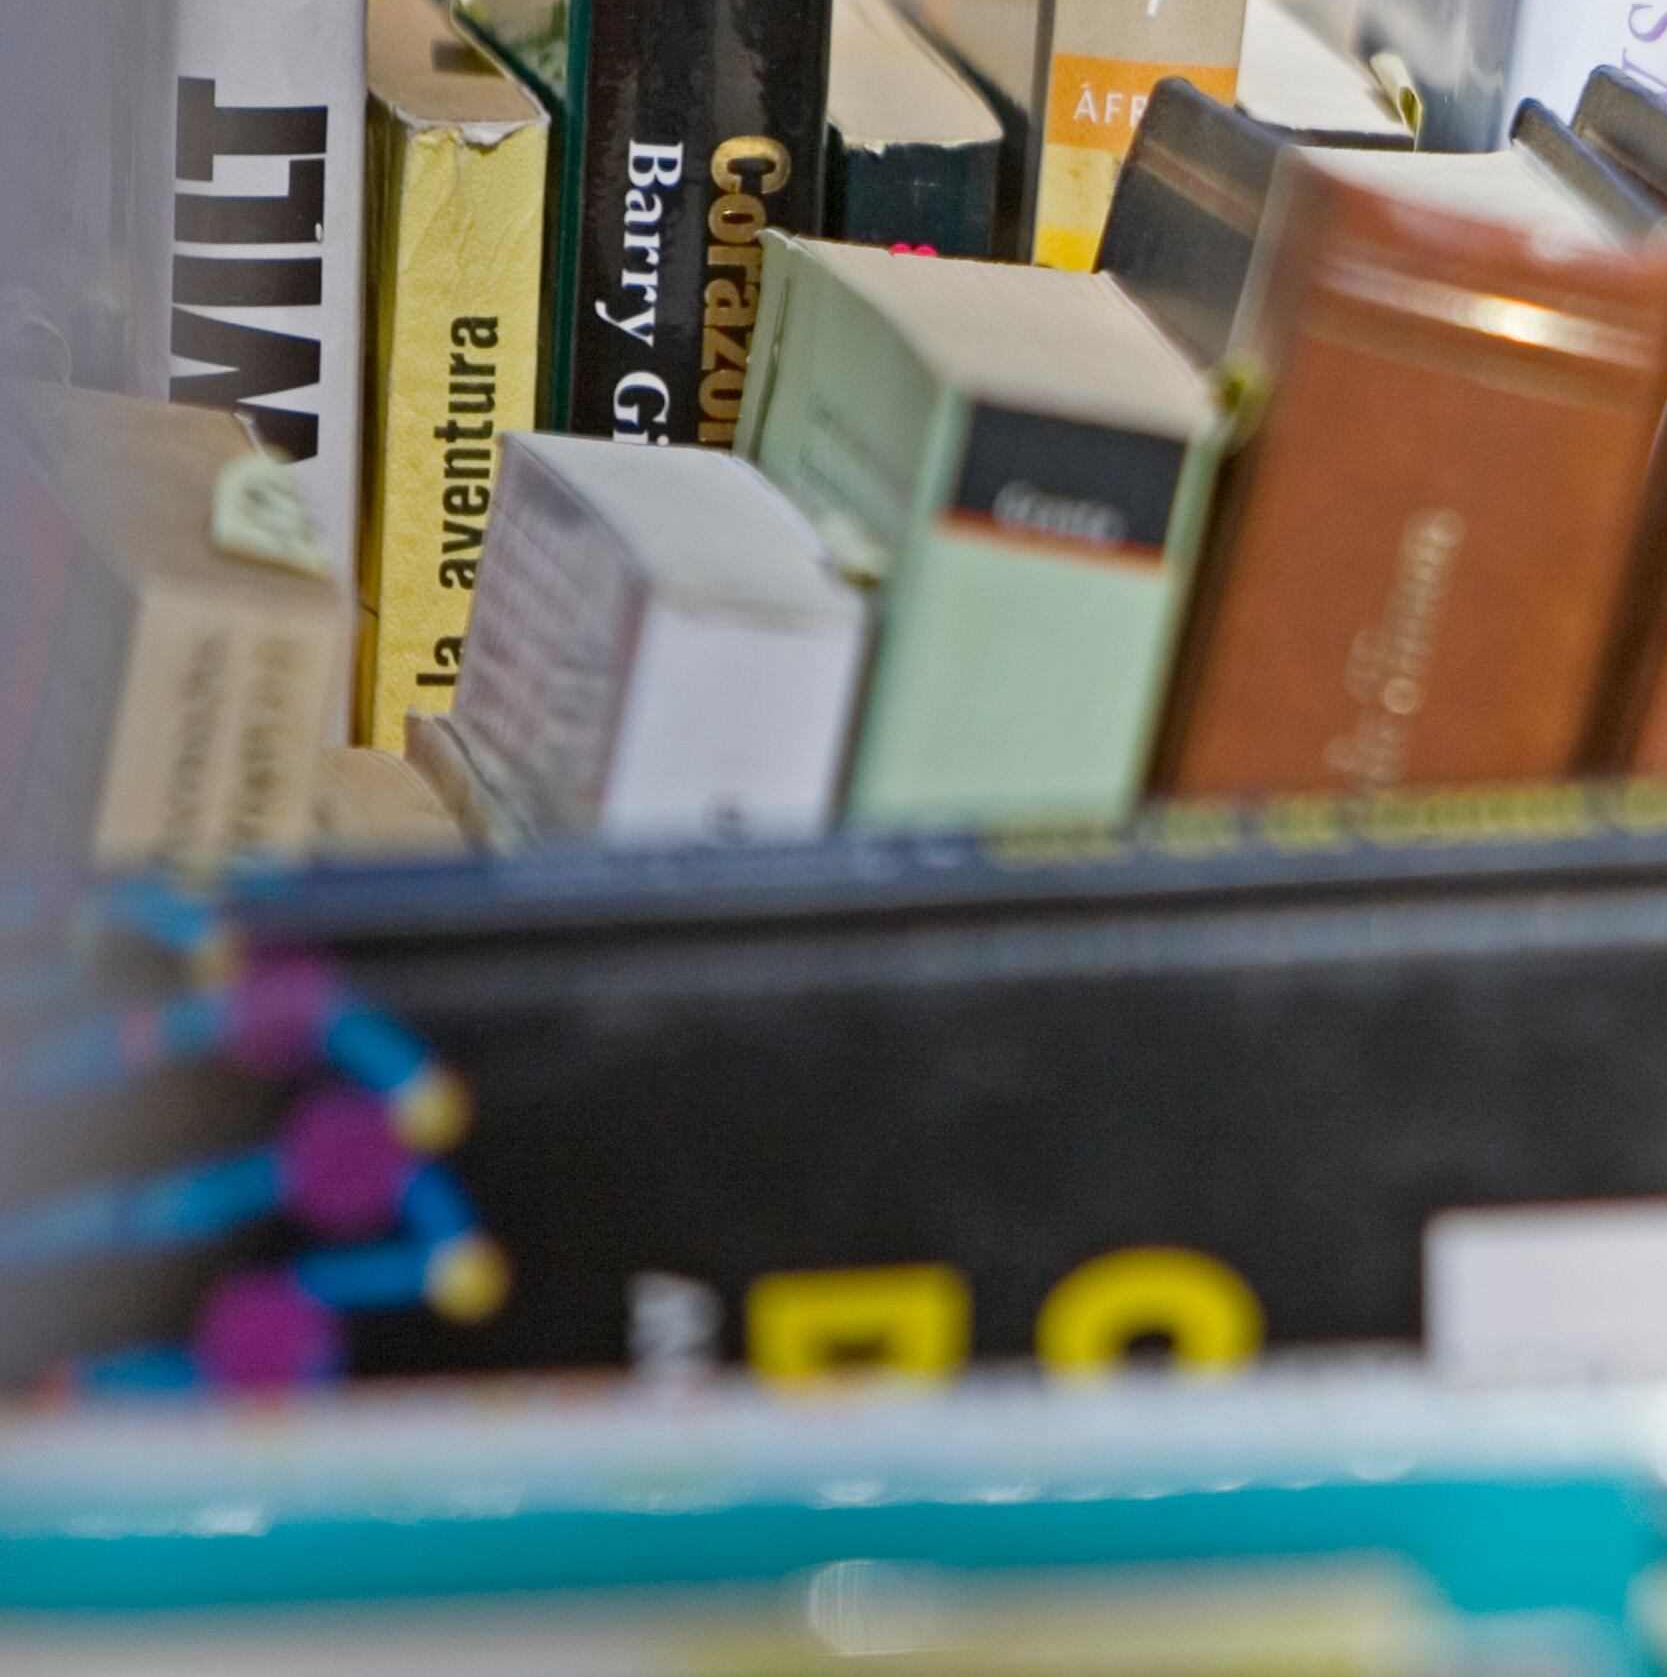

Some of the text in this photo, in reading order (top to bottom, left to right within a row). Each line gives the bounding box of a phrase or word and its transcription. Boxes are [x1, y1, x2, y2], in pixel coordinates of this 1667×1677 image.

[169, 76, 328, 464] WILT
[595, 138, 684, 348] Barry
[415, 315, 500, 686] la aventura
